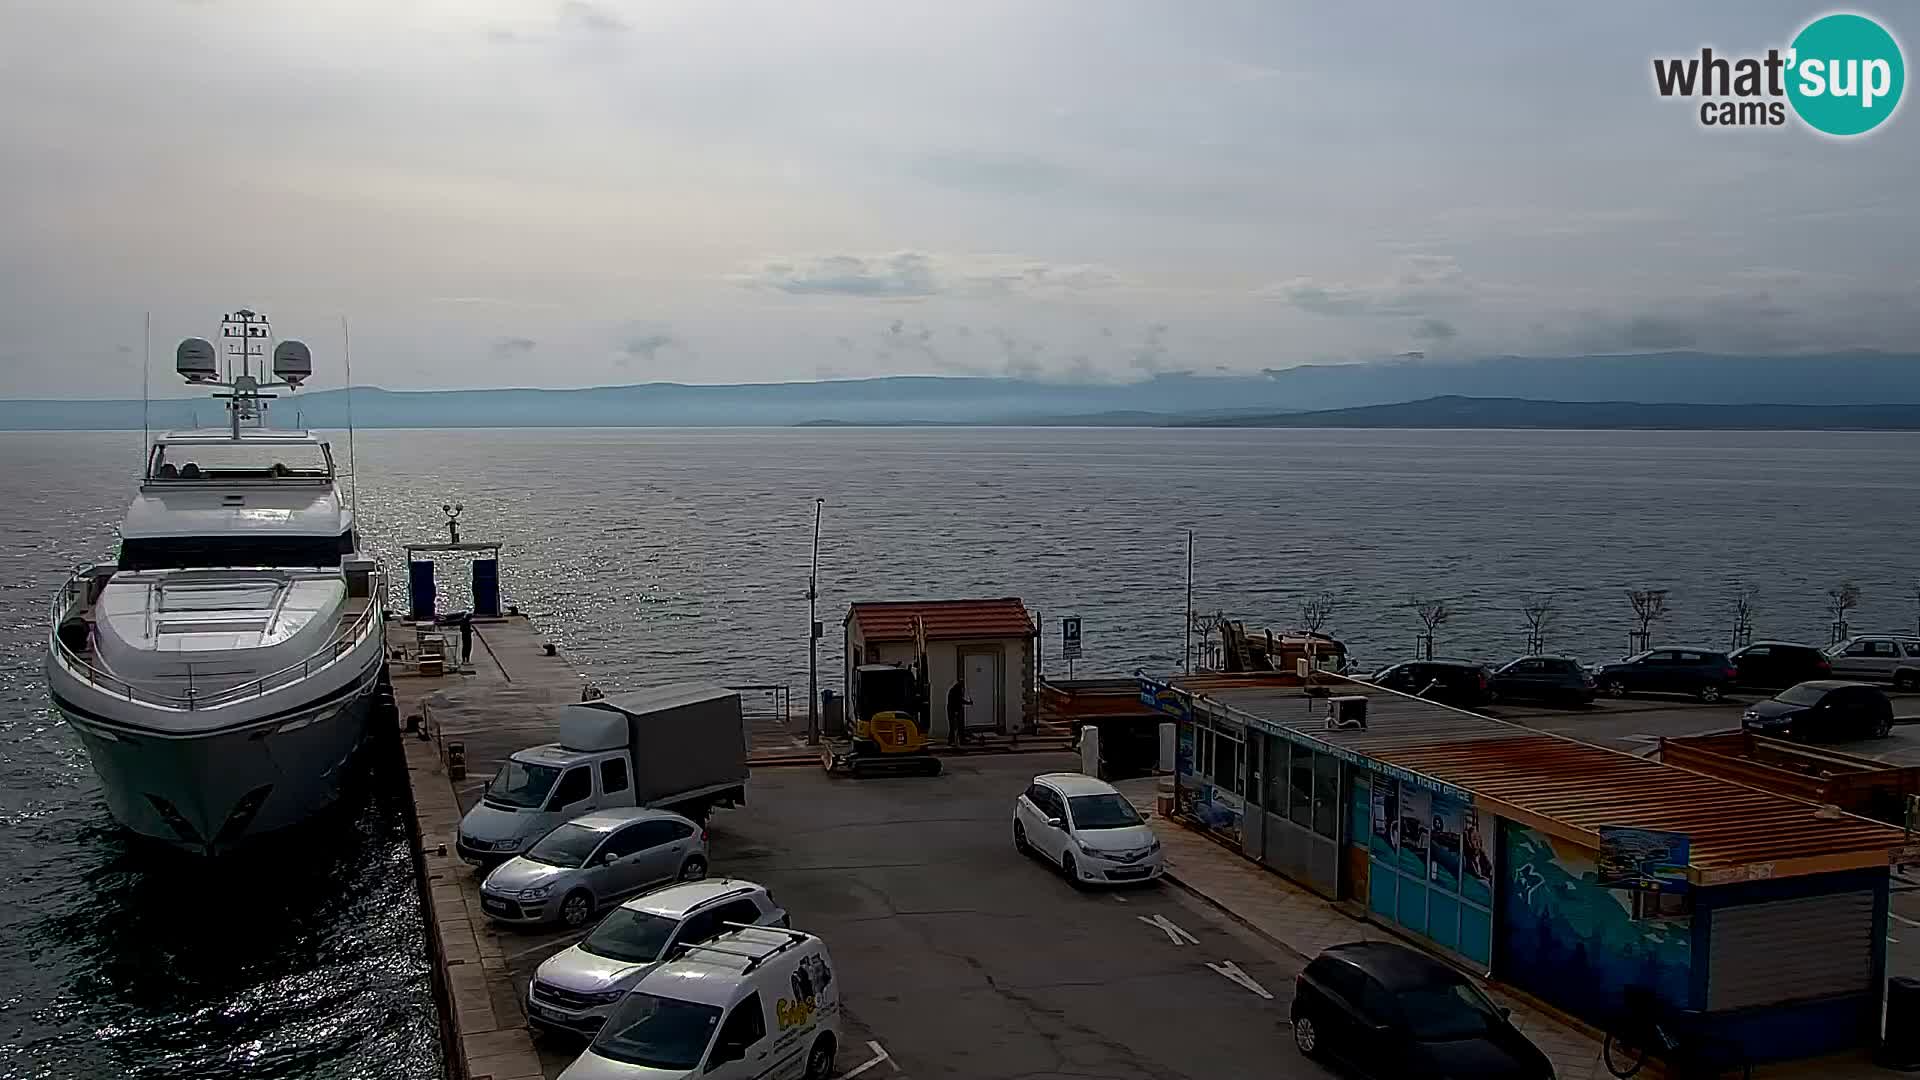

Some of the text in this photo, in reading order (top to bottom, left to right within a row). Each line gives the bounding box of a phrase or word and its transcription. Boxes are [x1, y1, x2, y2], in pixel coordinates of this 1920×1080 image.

[1067, 621, 1077, 637] P
[1383, 766, 1414, 783] STATION
[1416, 775, 1441, 793] TICKET
